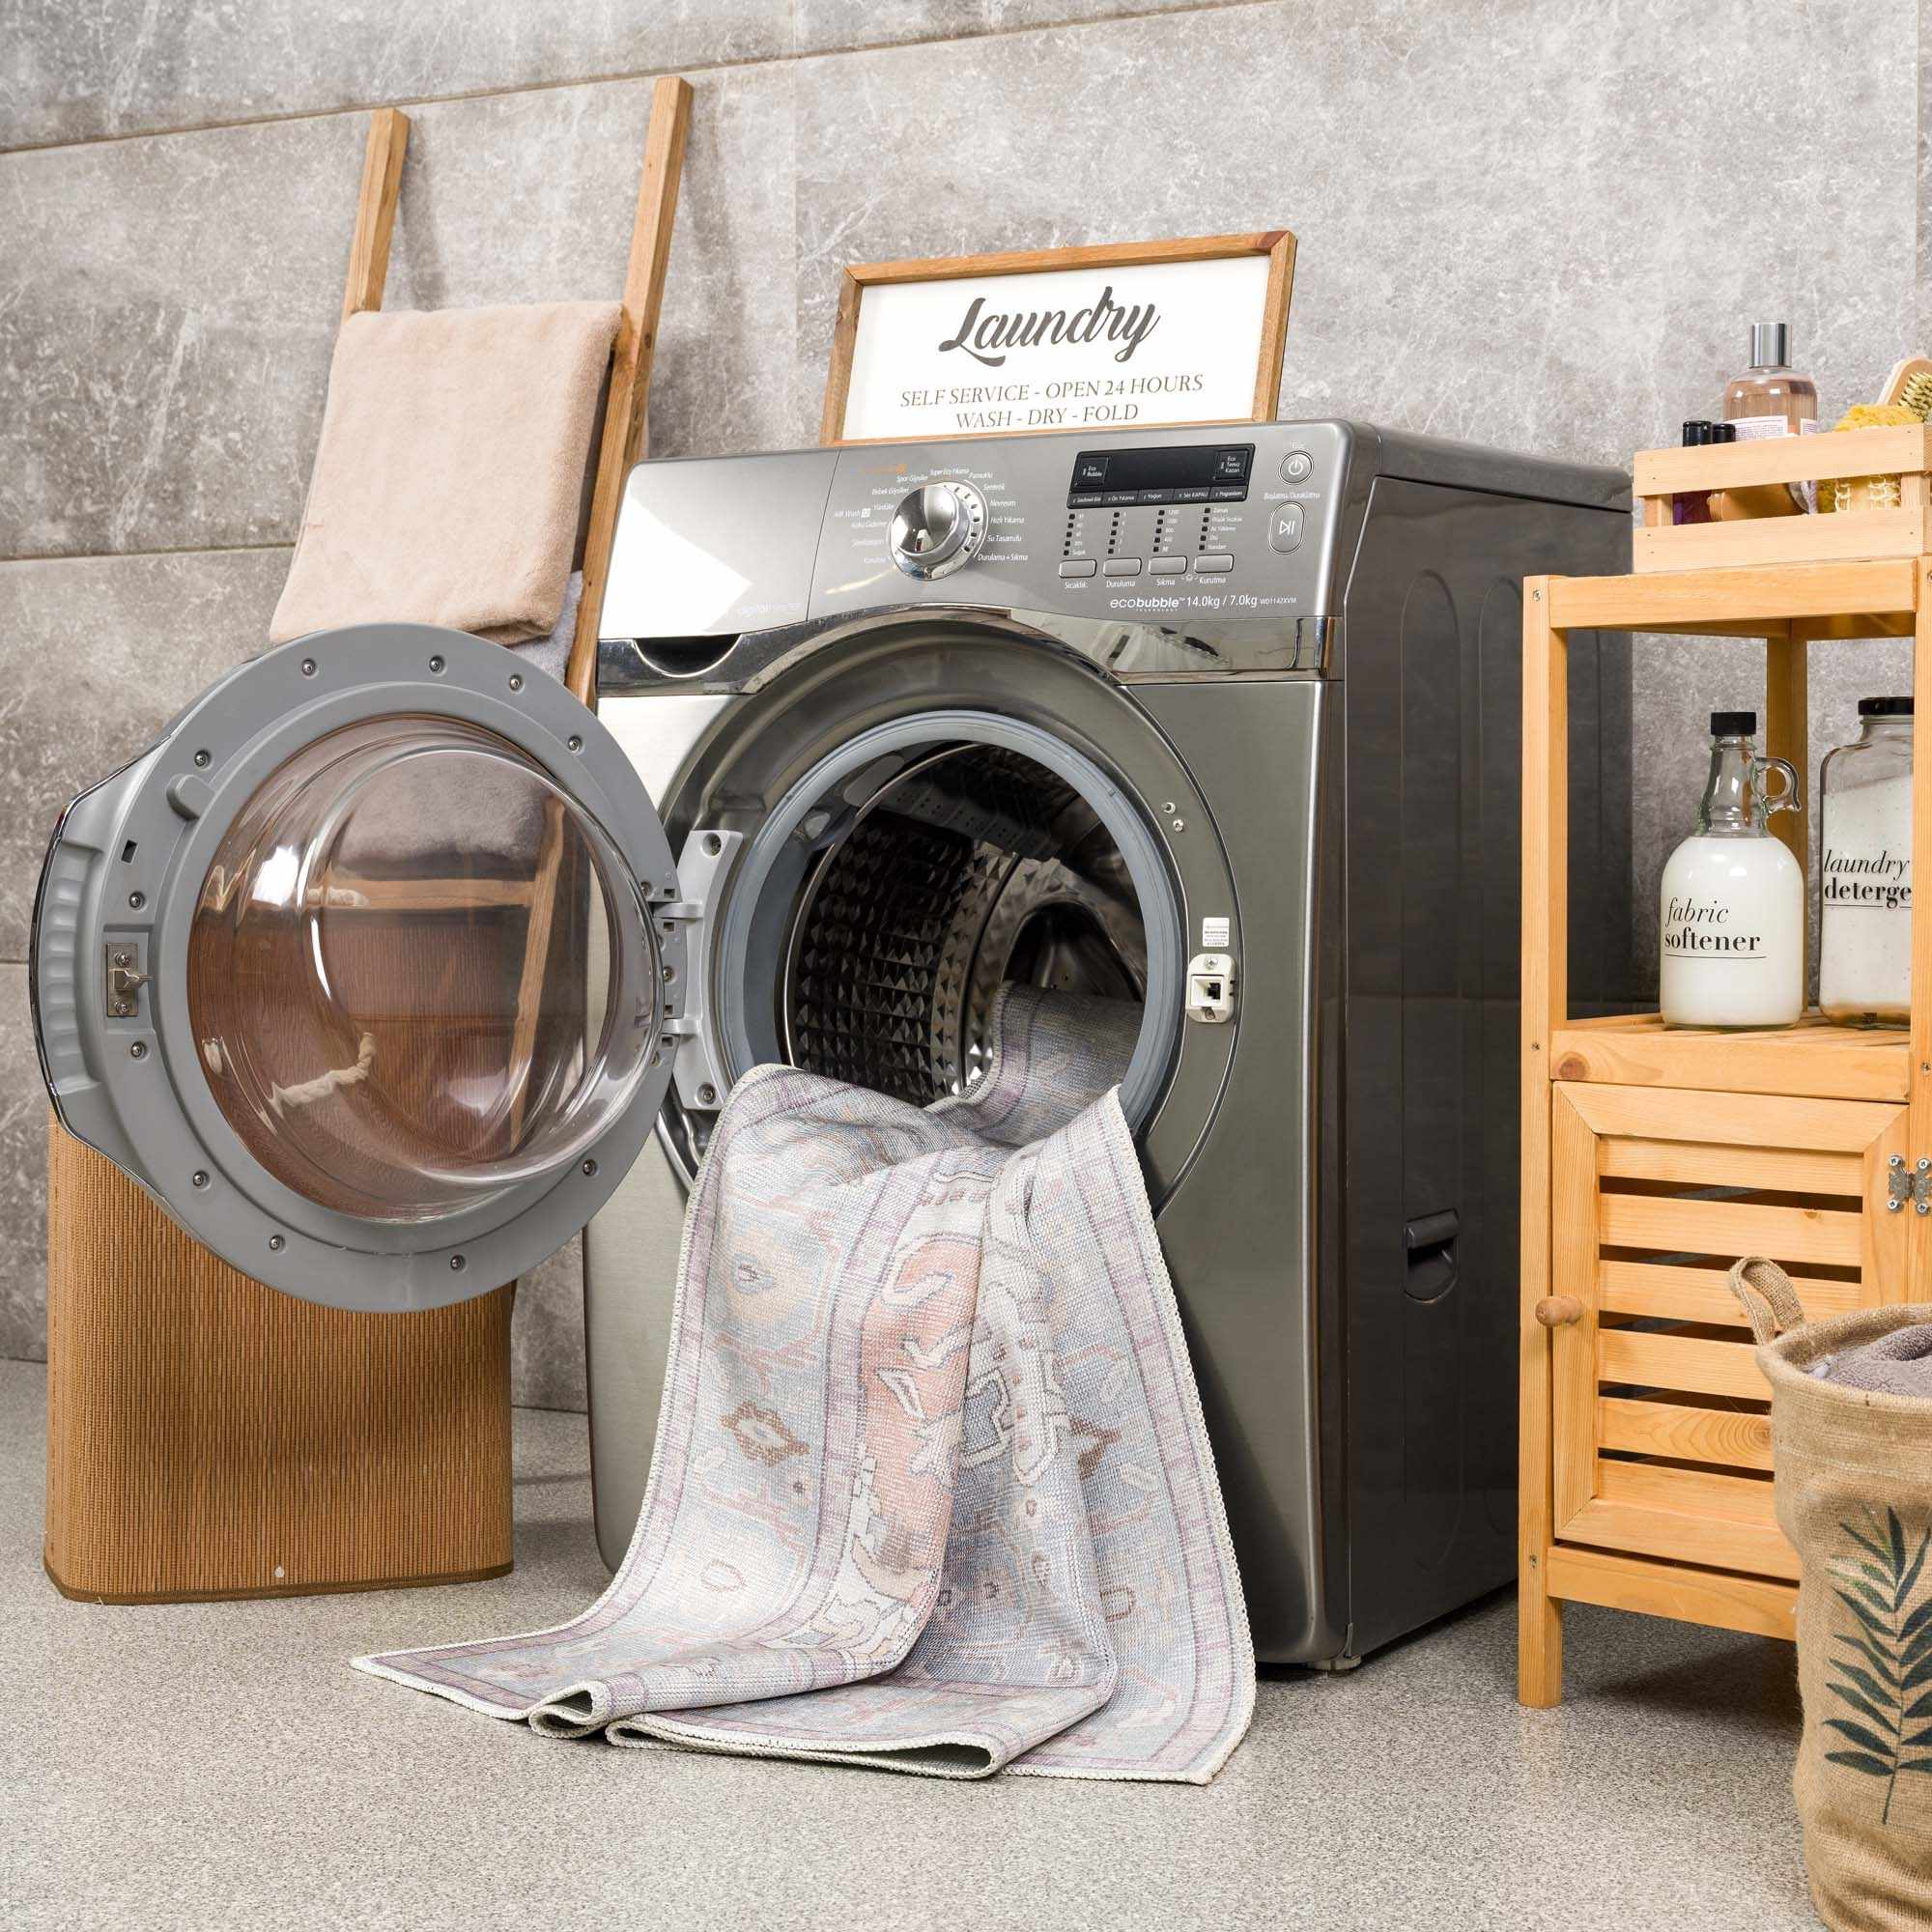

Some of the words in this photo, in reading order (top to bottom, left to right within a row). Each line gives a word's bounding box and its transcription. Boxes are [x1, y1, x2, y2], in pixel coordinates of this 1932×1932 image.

[938, 286, 1160, 367] Laundry
[900, 389, 946, 407] SELF
[950, 384, 1030, 404] SERVICE
[1045, 381, 1101, 399] OPEN
[1104, 379, 1125, 395] 24
[1129, 374, 1204, 394] HOURS
[956, 411, 1012, 429] WASH
[1028, 408, 1067, 425] DRY
[1083, 404, 1139, 422] FOLD
[1187, 595, 1220, 610] 14.0kg
[1230, 594, 1258, 609] 7.0kg
[1824, 849, 1911, 881] laundry
[1824, 877, 1912, 909] deterge
[1664, 896, 1729, 927] fabric
[1664, 926, 1761, 951] softener
